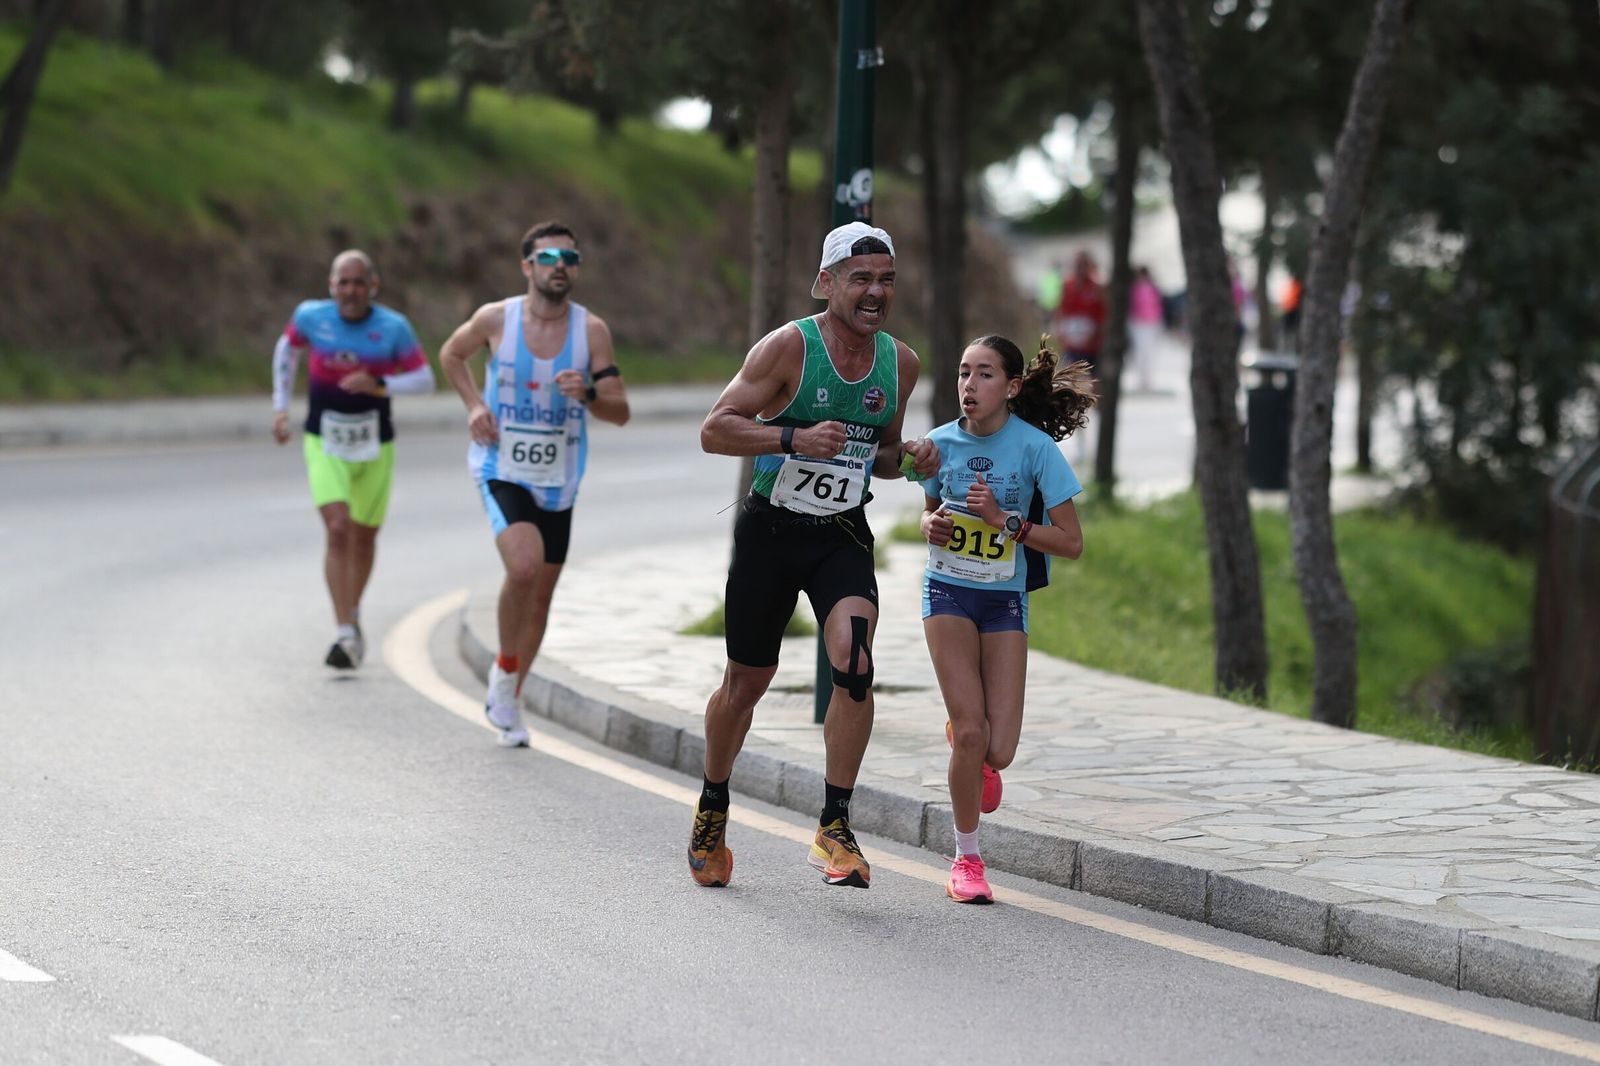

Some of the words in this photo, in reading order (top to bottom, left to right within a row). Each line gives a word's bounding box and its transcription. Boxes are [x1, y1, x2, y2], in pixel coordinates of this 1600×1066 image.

[512, 441, 558, 465] 669
[967, 458, 993, 471] TROPS
[793, 468, 851, 504] 761
[949, 525, 1005, 560] 915
